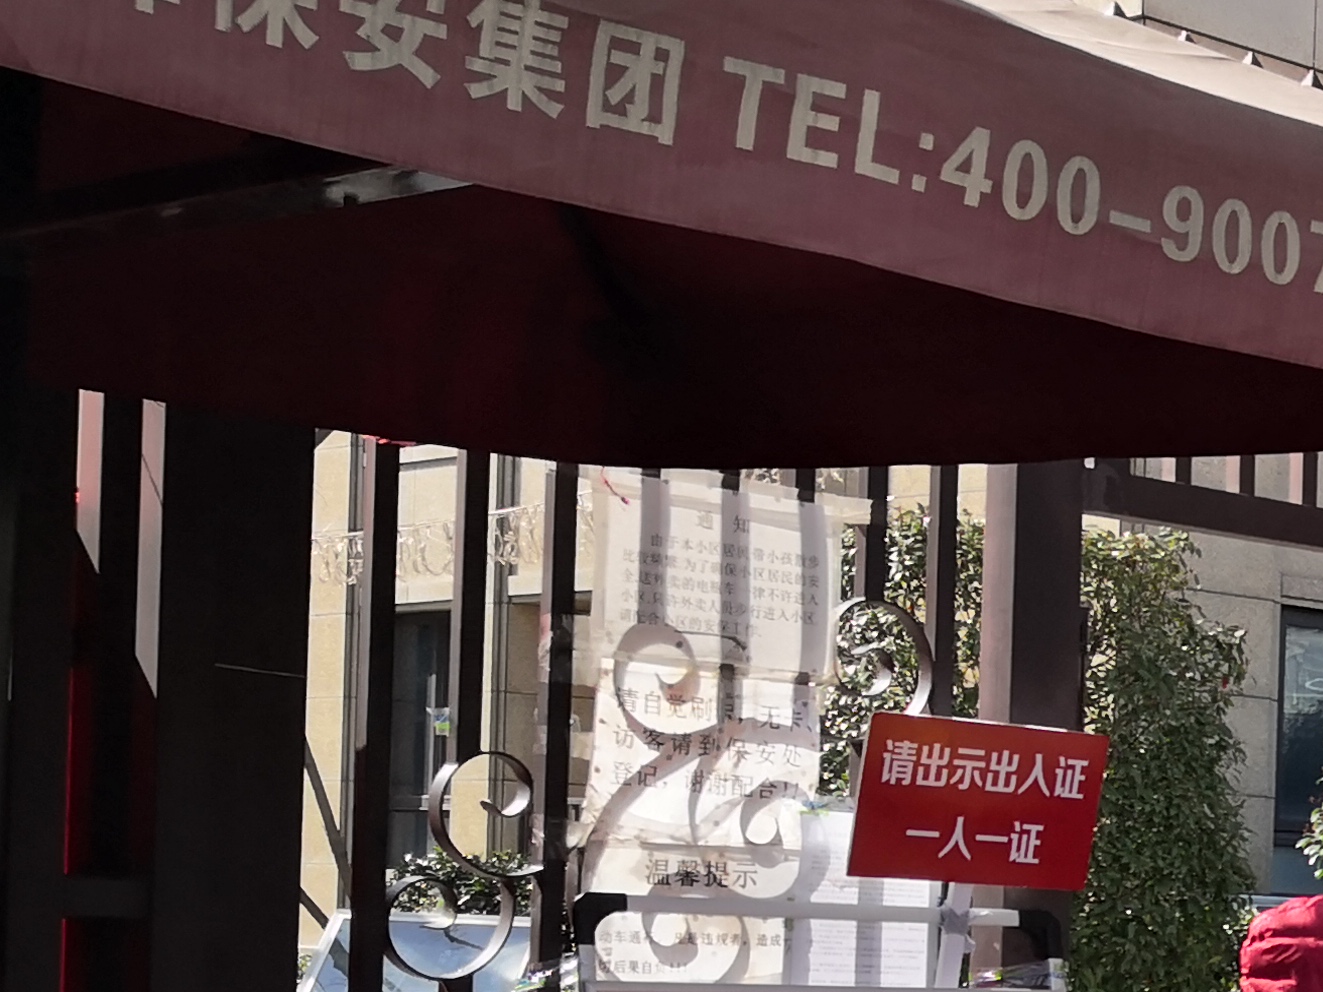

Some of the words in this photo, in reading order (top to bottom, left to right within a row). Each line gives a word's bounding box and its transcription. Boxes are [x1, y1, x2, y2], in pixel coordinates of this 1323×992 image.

[880, 738, 1090, 801] 请出示出入证
[905, 819, 1044, 865] 一人一证
[646, 859, 758, 890] 温馨提示
